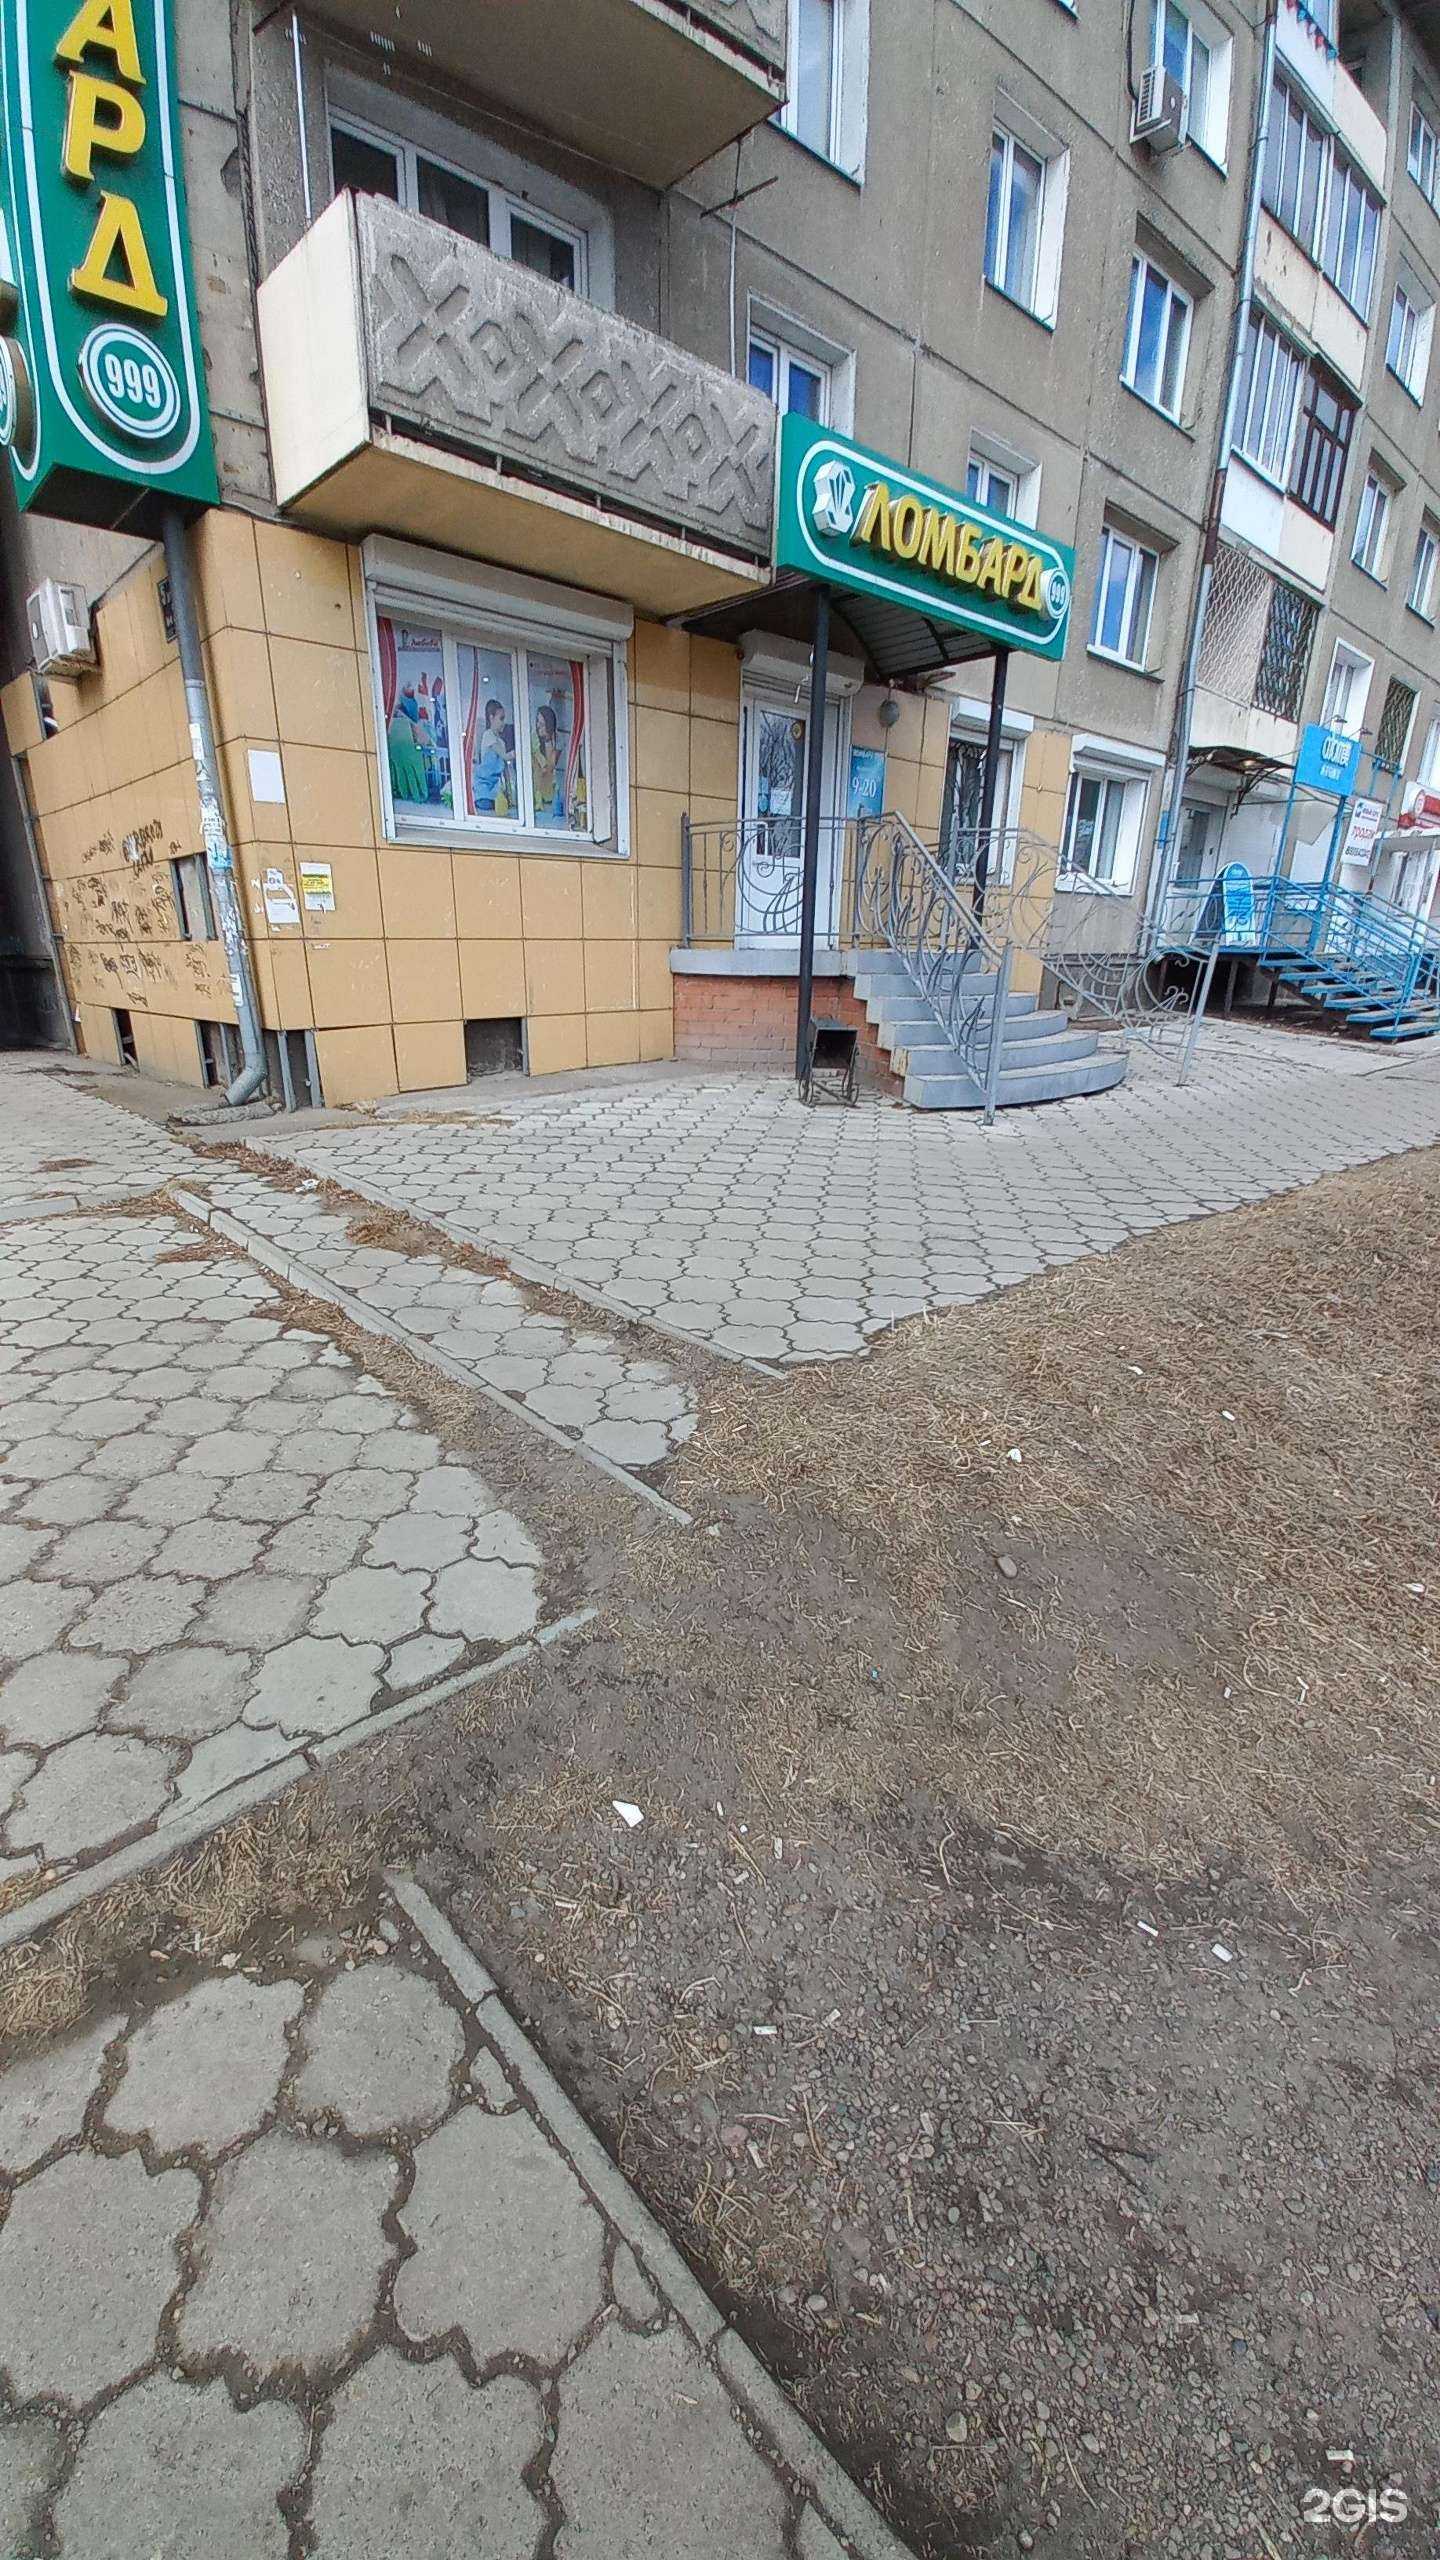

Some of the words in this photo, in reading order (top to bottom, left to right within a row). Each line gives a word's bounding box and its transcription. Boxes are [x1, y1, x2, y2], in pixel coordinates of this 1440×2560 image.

[57, 0, 169, 317] АРД
[104, 353, 161, 409] 999
[857, 481, 1043, 612] ЛОМБАРД
